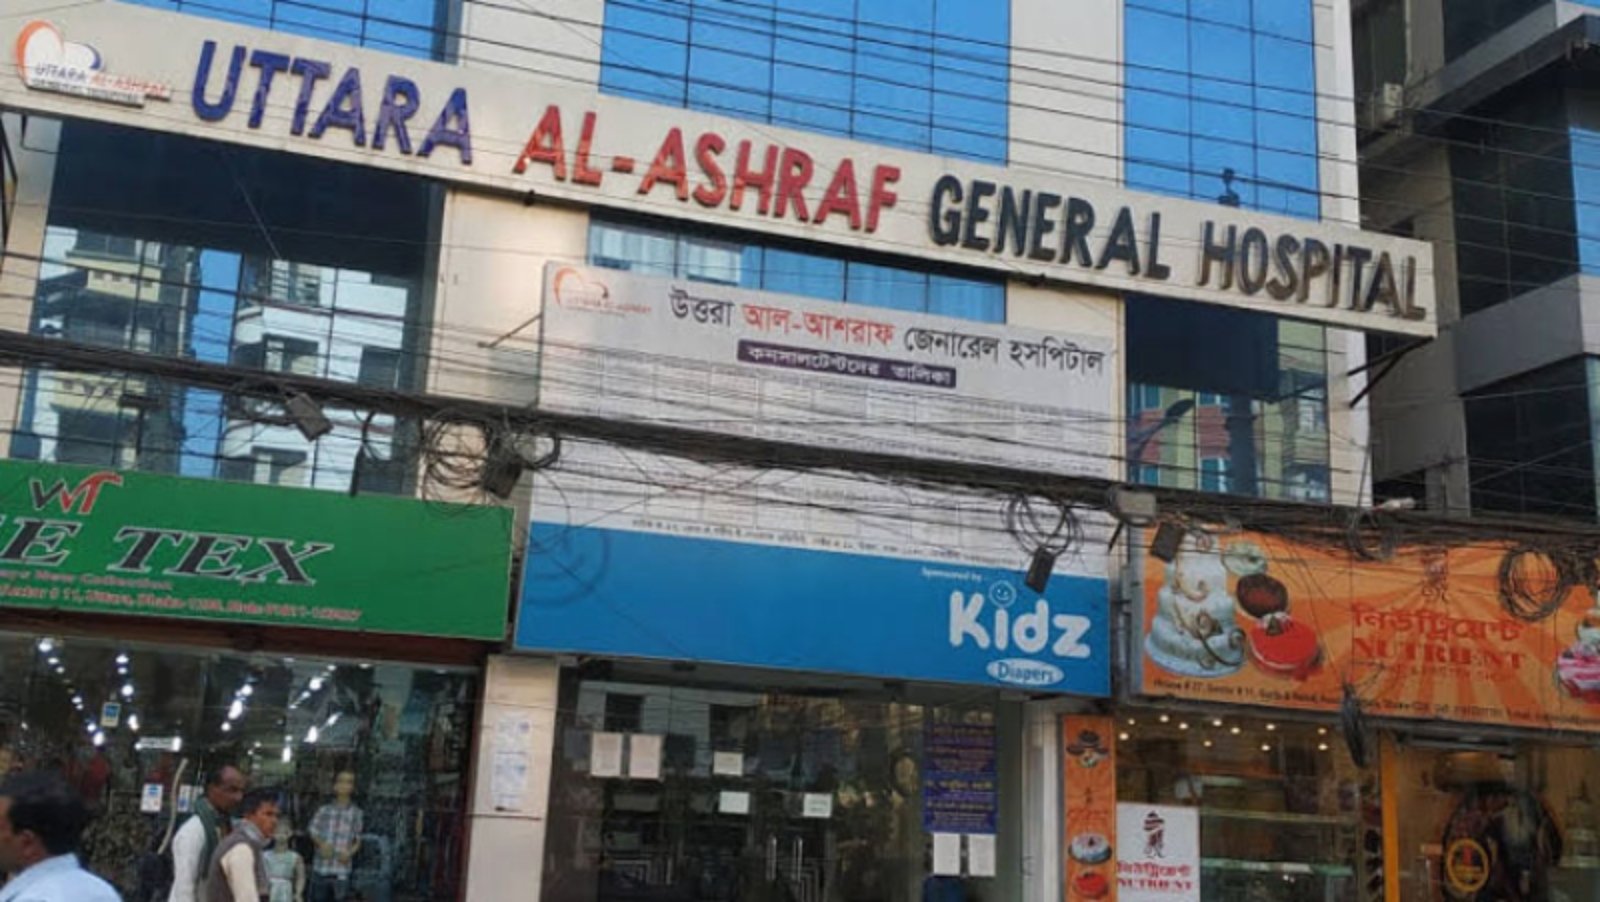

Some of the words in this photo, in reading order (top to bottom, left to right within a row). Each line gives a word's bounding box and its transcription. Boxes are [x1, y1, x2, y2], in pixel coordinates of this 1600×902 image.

[191, 40, 473, 165] UTTARA
[512, 104, 902, 234] AL-ASHRAF
[930, 173, 1171, 281] GENERAL
[1196, 219, 1427, 321] HOSPITAL
[668, 286, 735, 327] উত্তরা
[741, 303, 896, 347] আল-আশরাফ
[904, 328, 1001, 362] জেনারেল
[1007, 335, 1105, 377] হসপিটাল
[106, 525, 335, 586] TEX
[949, 580, 1091, 659] Kidz
[998, 661, 1054, 684] Diapers
[1353, 637, 1526, 670] NUTRIENT
[1116, 878, 1193, 892] NUTRIENT
